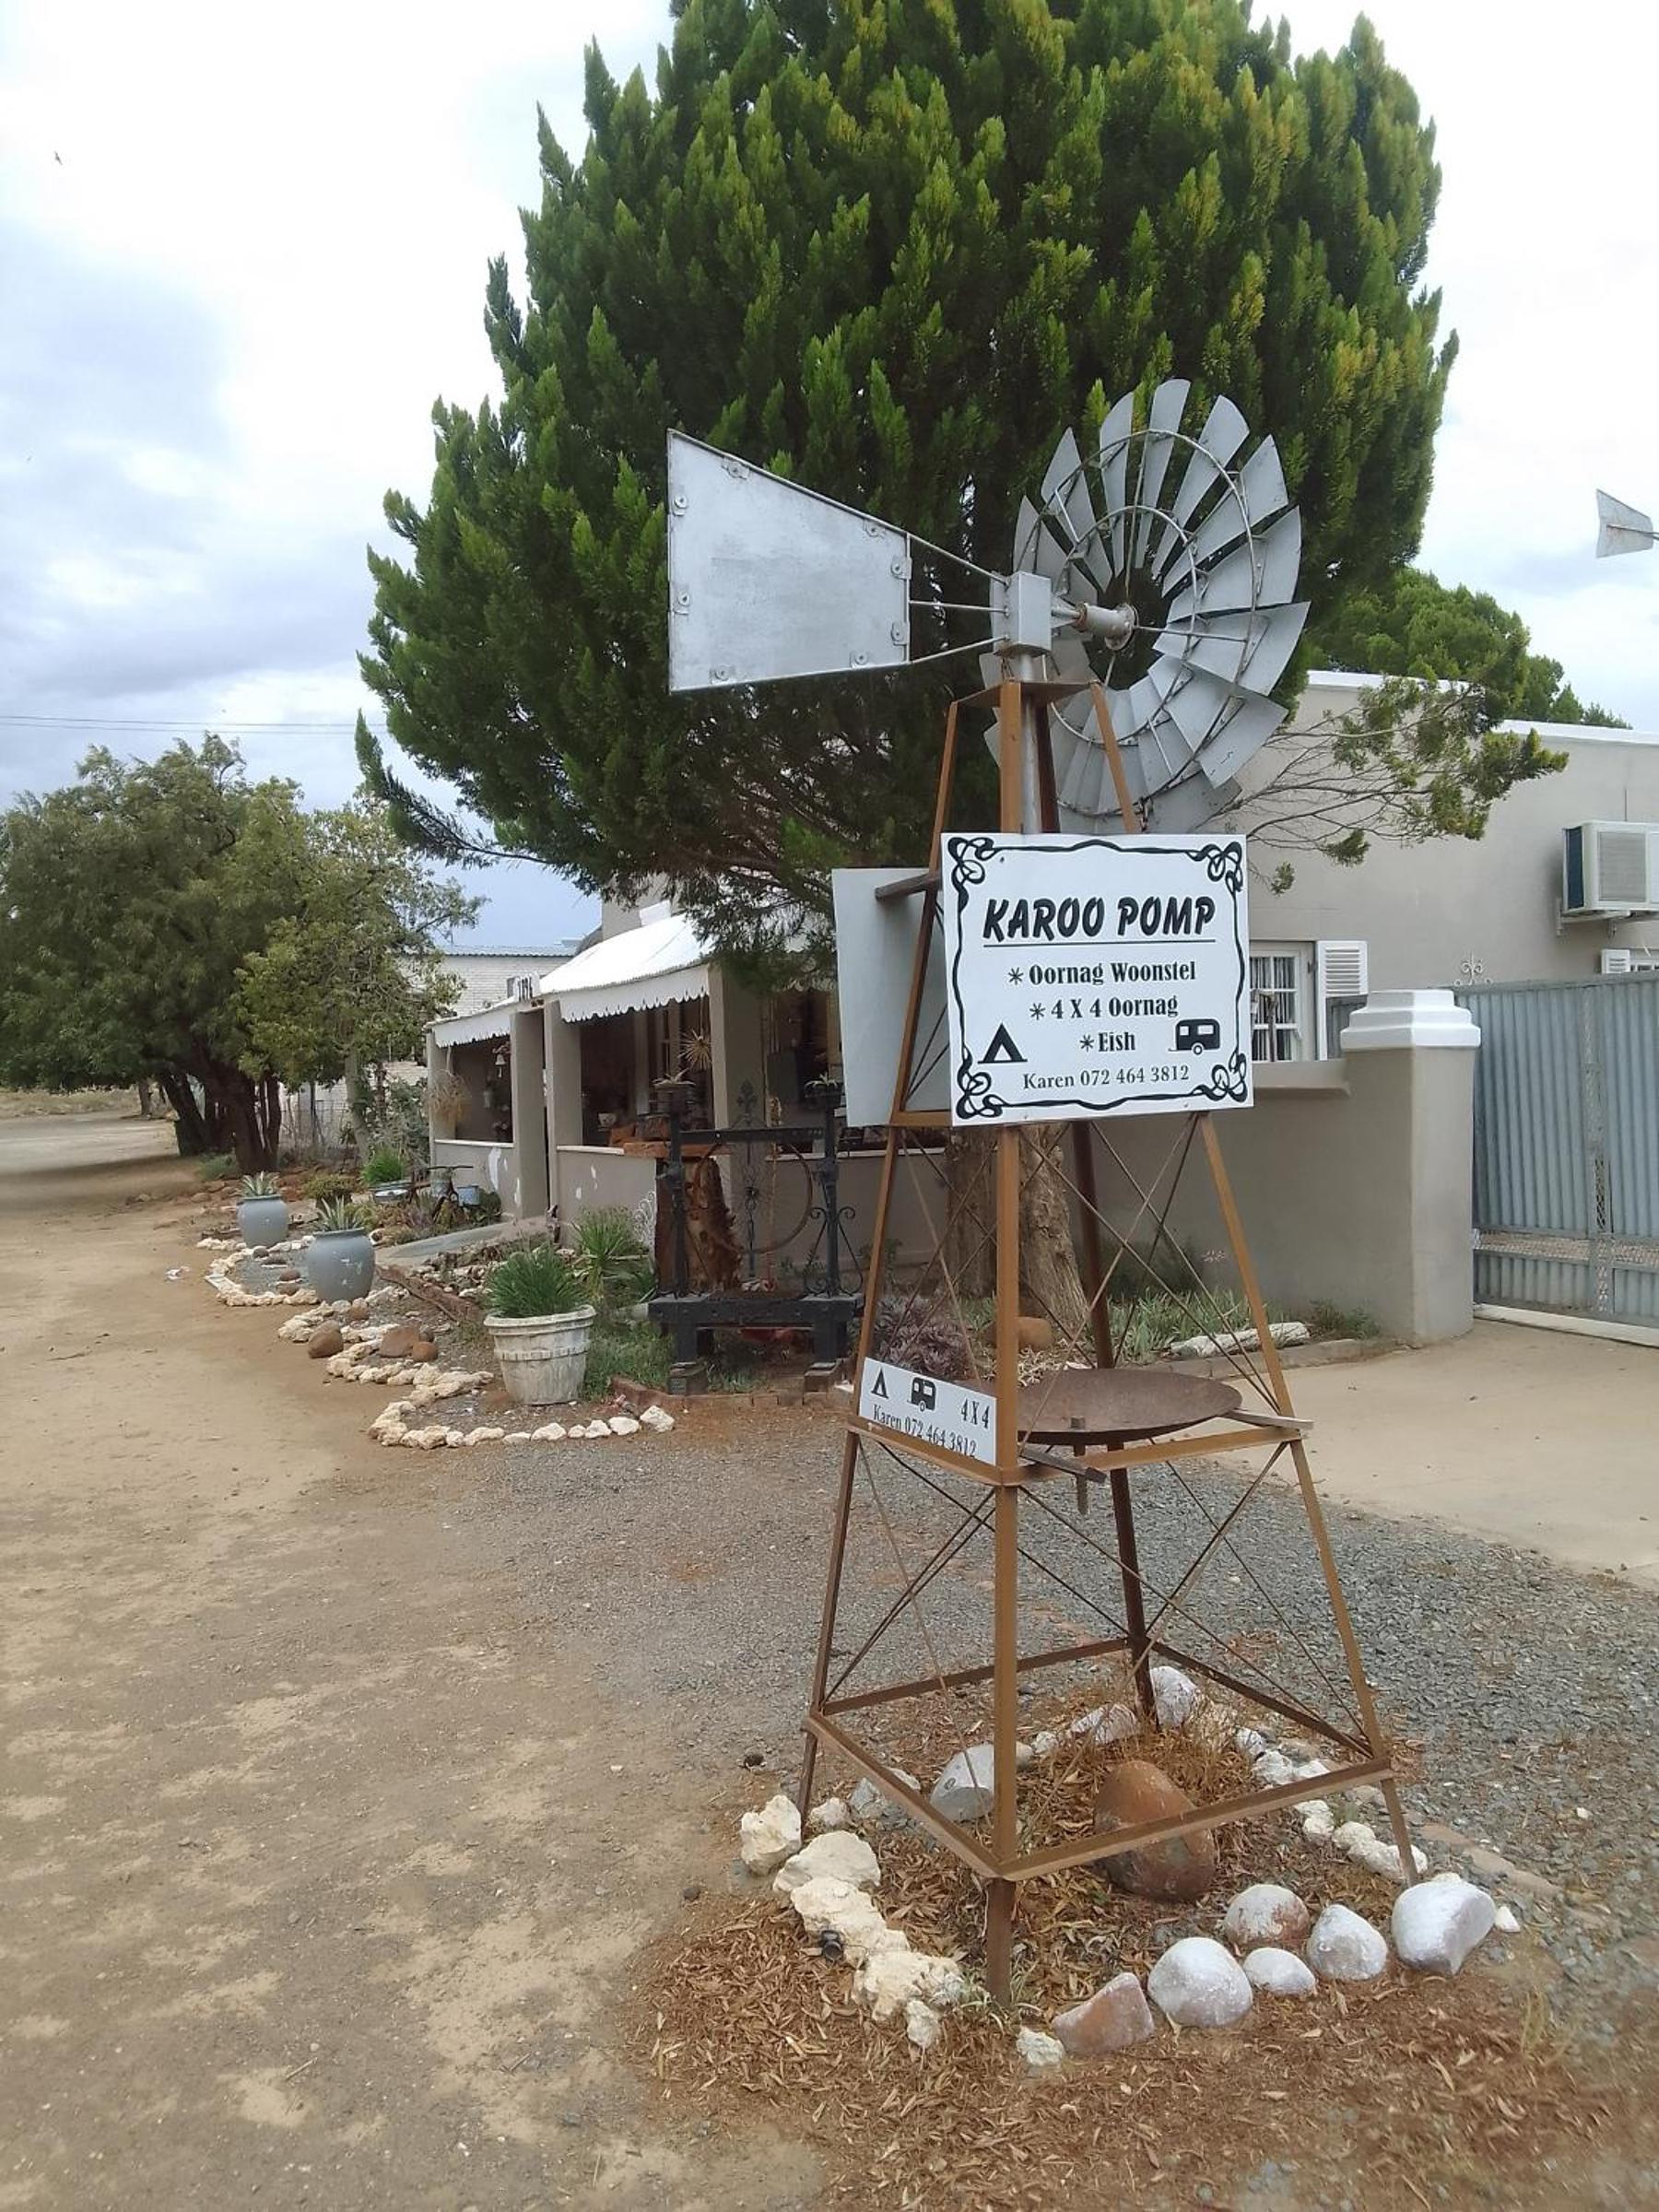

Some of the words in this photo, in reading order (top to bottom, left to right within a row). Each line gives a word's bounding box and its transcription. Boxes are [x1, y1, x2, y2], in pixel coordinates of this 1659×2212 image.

[982, 897, 1105, 942] KAROO
[1117, 896, 1216, 936] POMP
[1029, 963, 1104, 985] Oornag
[1110, 961, 1195, 982] Woonstel
[1109, 995, 1179, 1018] Oornag
[1098, 1031, 1136, 1053] Eish
[1023, 1072, 1075, 1089] Karen
[1080, 1069, 1110, 1086] 072
[1116, 1067, 1145, 1084] 464
[1151, 1065, 1189, 1082] 3812
[874, 1404, 901, 1430] Karen
[904, 1416, 923, 1439] 072
[926, 1425, 946, 1446] 464
[950, 1432, 977, 1458] 3812
